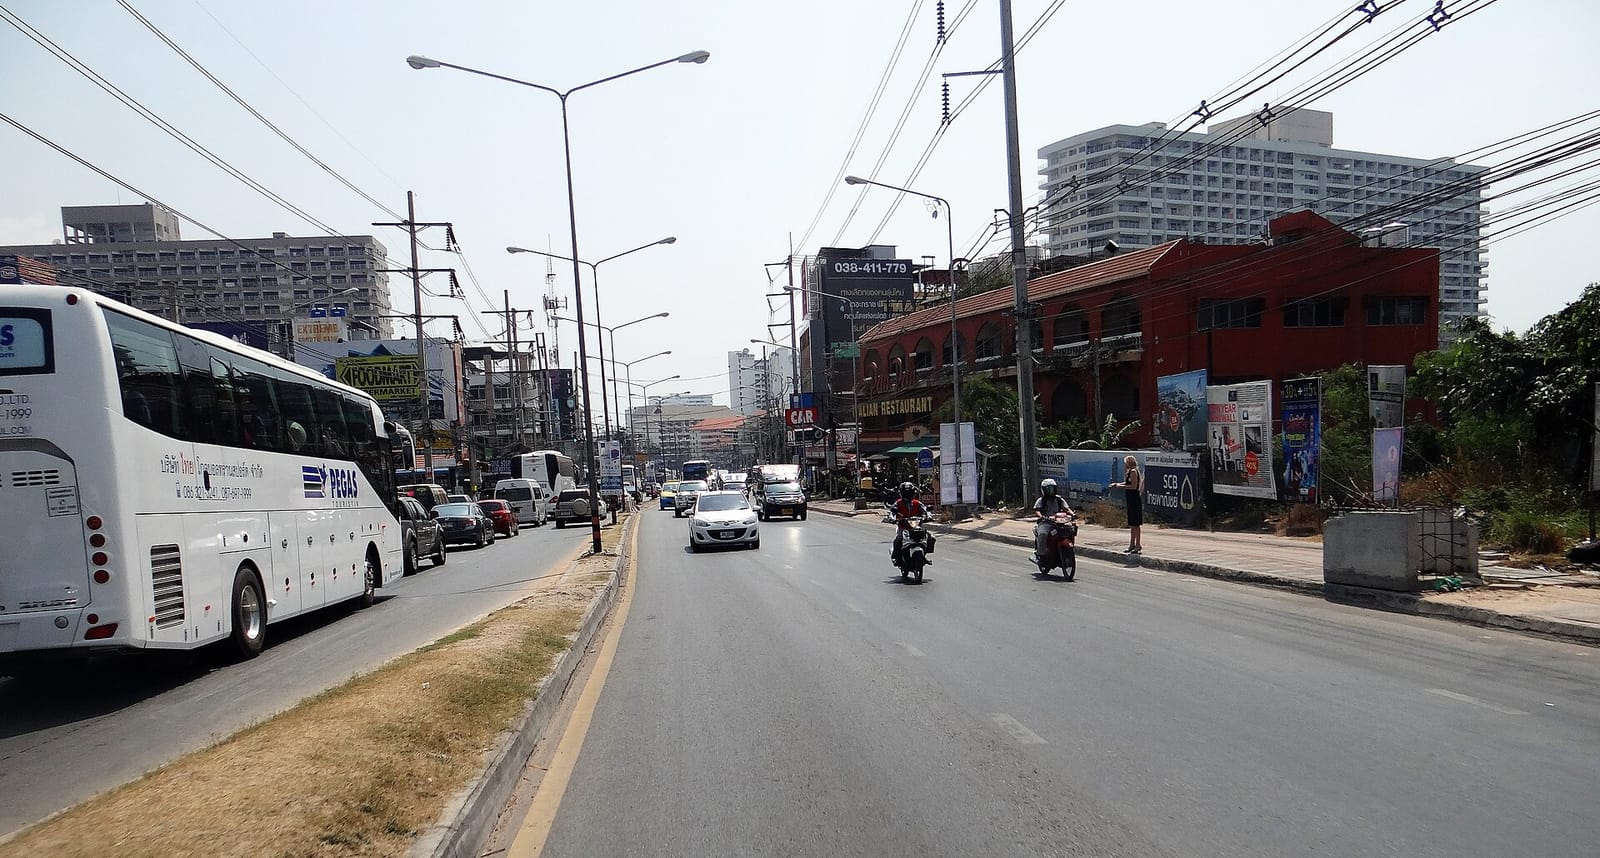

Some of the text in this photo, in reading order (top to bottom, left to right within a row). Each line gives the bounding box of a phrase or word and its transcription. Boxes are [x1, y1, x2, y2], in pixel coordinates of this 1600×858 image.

[834, 262, 907, 274] 038-411-779
[297, 323, 339, 334] EXTREME
[352, 365, 412, 387] FOODMART
[364, 387, 417, 397] PERMARKET
[881, 396, 933, 416] RESTAURANT
[790, 410, 814, 425] CAR
[180, 451, 195, 475] ไทย
[329, 468, 359, 499] PEGAS
[1163, 474, 1179, 490] SCB
[1146, 490, 1179, 508] ไทยพาณิชย์
